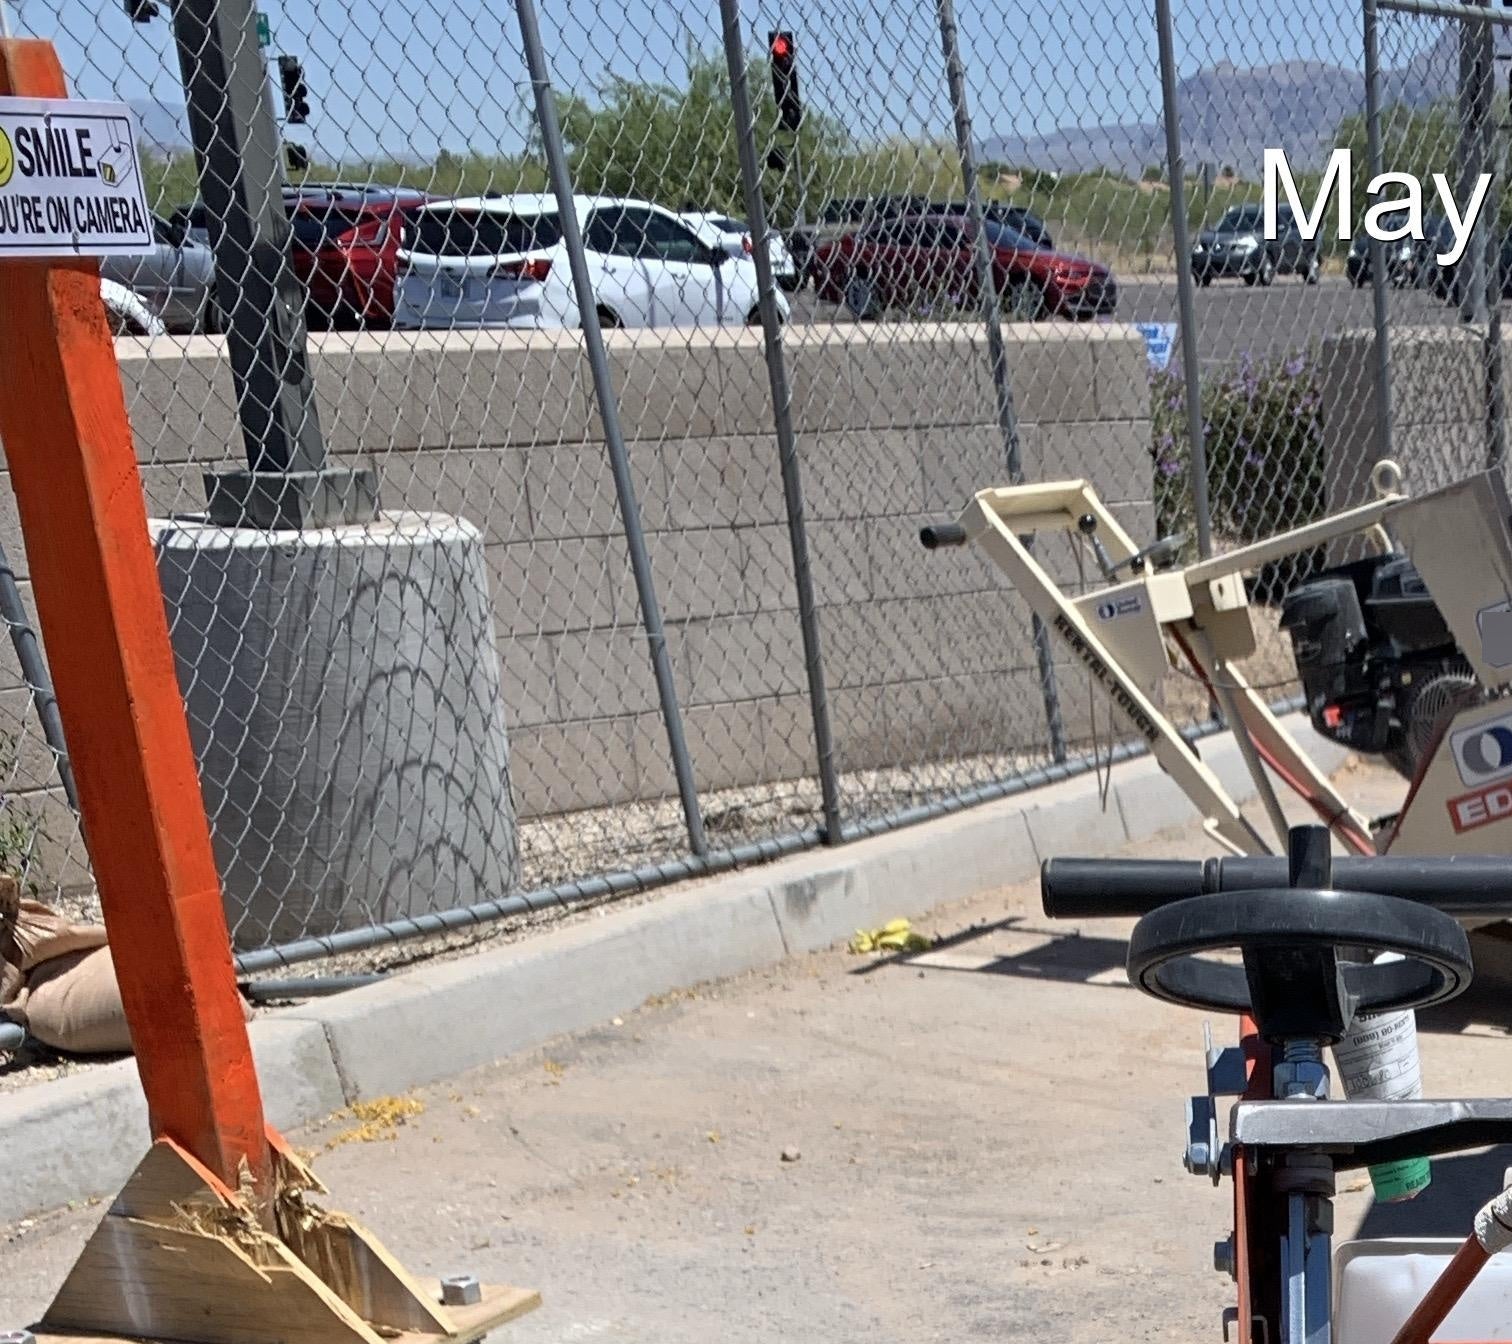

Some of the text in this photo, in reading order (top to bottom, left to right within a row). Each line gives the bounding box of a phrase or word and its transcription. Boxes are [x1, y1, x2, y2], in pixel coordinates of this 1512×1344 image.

[15, 126, 97, 178] SMILE
[0, 194, 146, 234] OU'RE ON CAMERA
